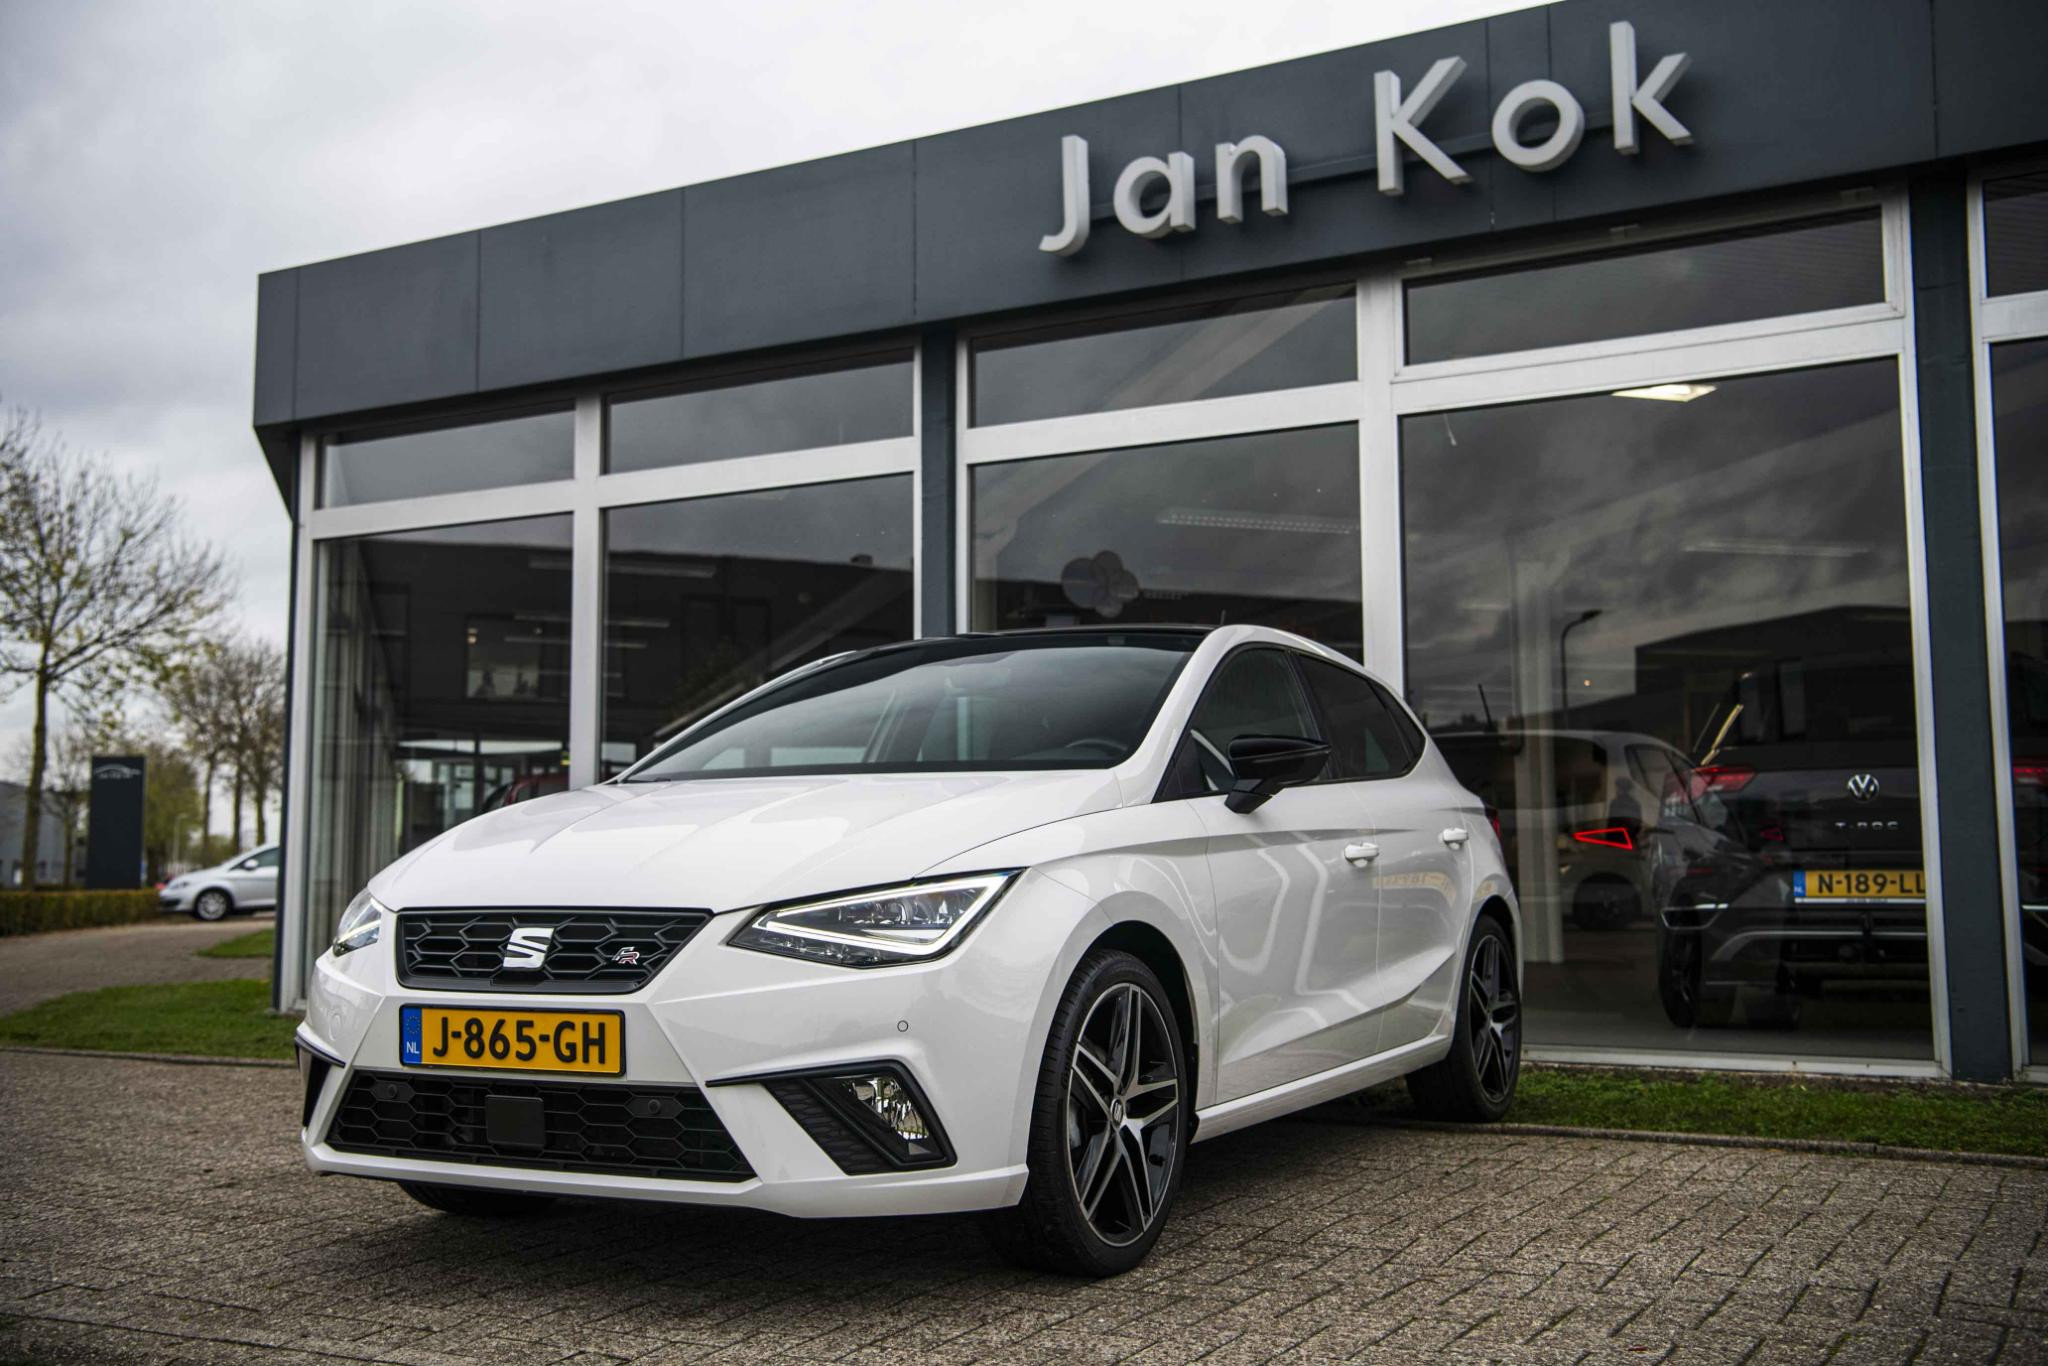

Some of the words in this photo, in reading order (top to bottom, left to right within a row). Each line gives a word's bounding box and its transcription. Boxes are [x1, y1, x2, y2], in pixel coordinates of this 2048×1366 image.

[1039, 134, 1288, 255] Jan
[1374, 21, 1692, 195] Kok
[406, 1041, 420, 1054] NL
[433, 1017, 606, 1064] J-865-GH
